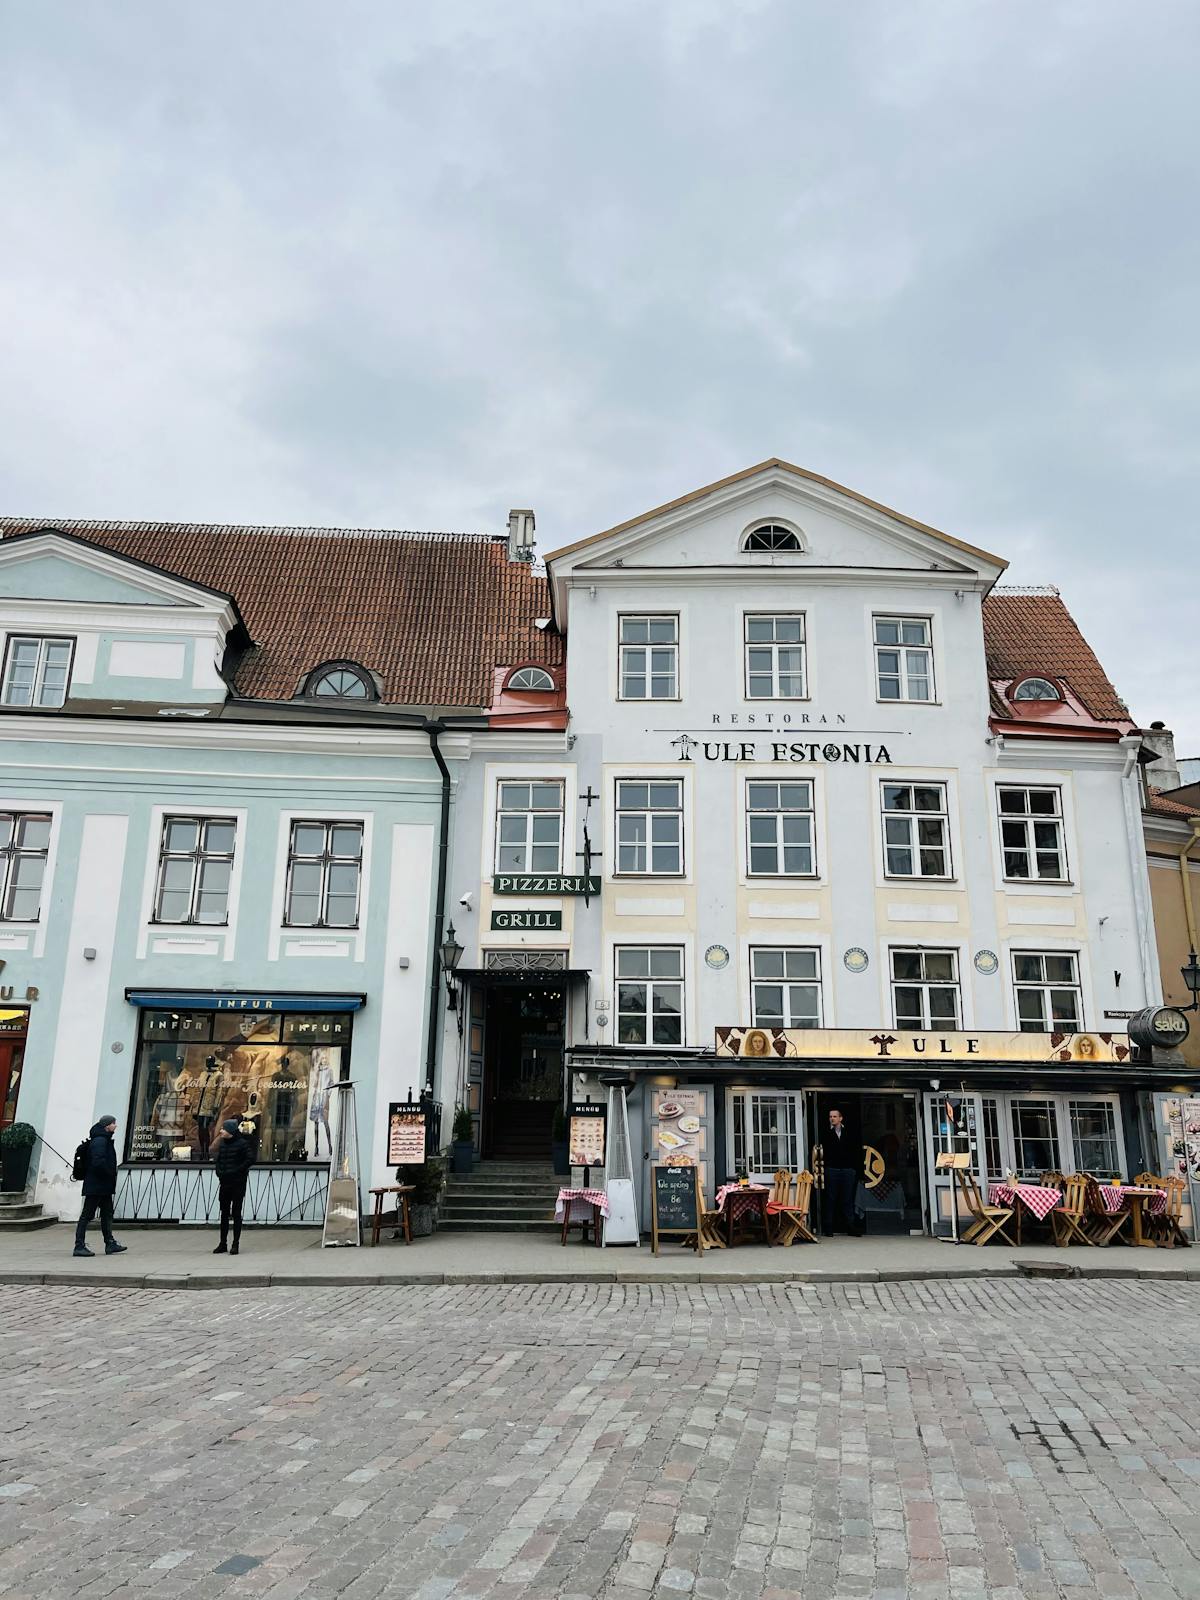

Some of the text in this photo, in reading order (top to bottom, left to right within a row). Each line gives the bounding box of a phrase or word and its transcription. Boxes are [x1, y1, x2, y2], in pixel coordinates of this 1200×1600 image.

[712, 713, 847, 724] RESTORAN
[772, 743, 893, 763] ESTONIA
[496, 913, 557, 927] GRILL
[217, 1000, 274, 1009] INFUR
[149, 1020, 203, 1030] INFUR
[290, 1023, 342, 1033] INFUR
[1154, 1015, 1187, 1032] saku
